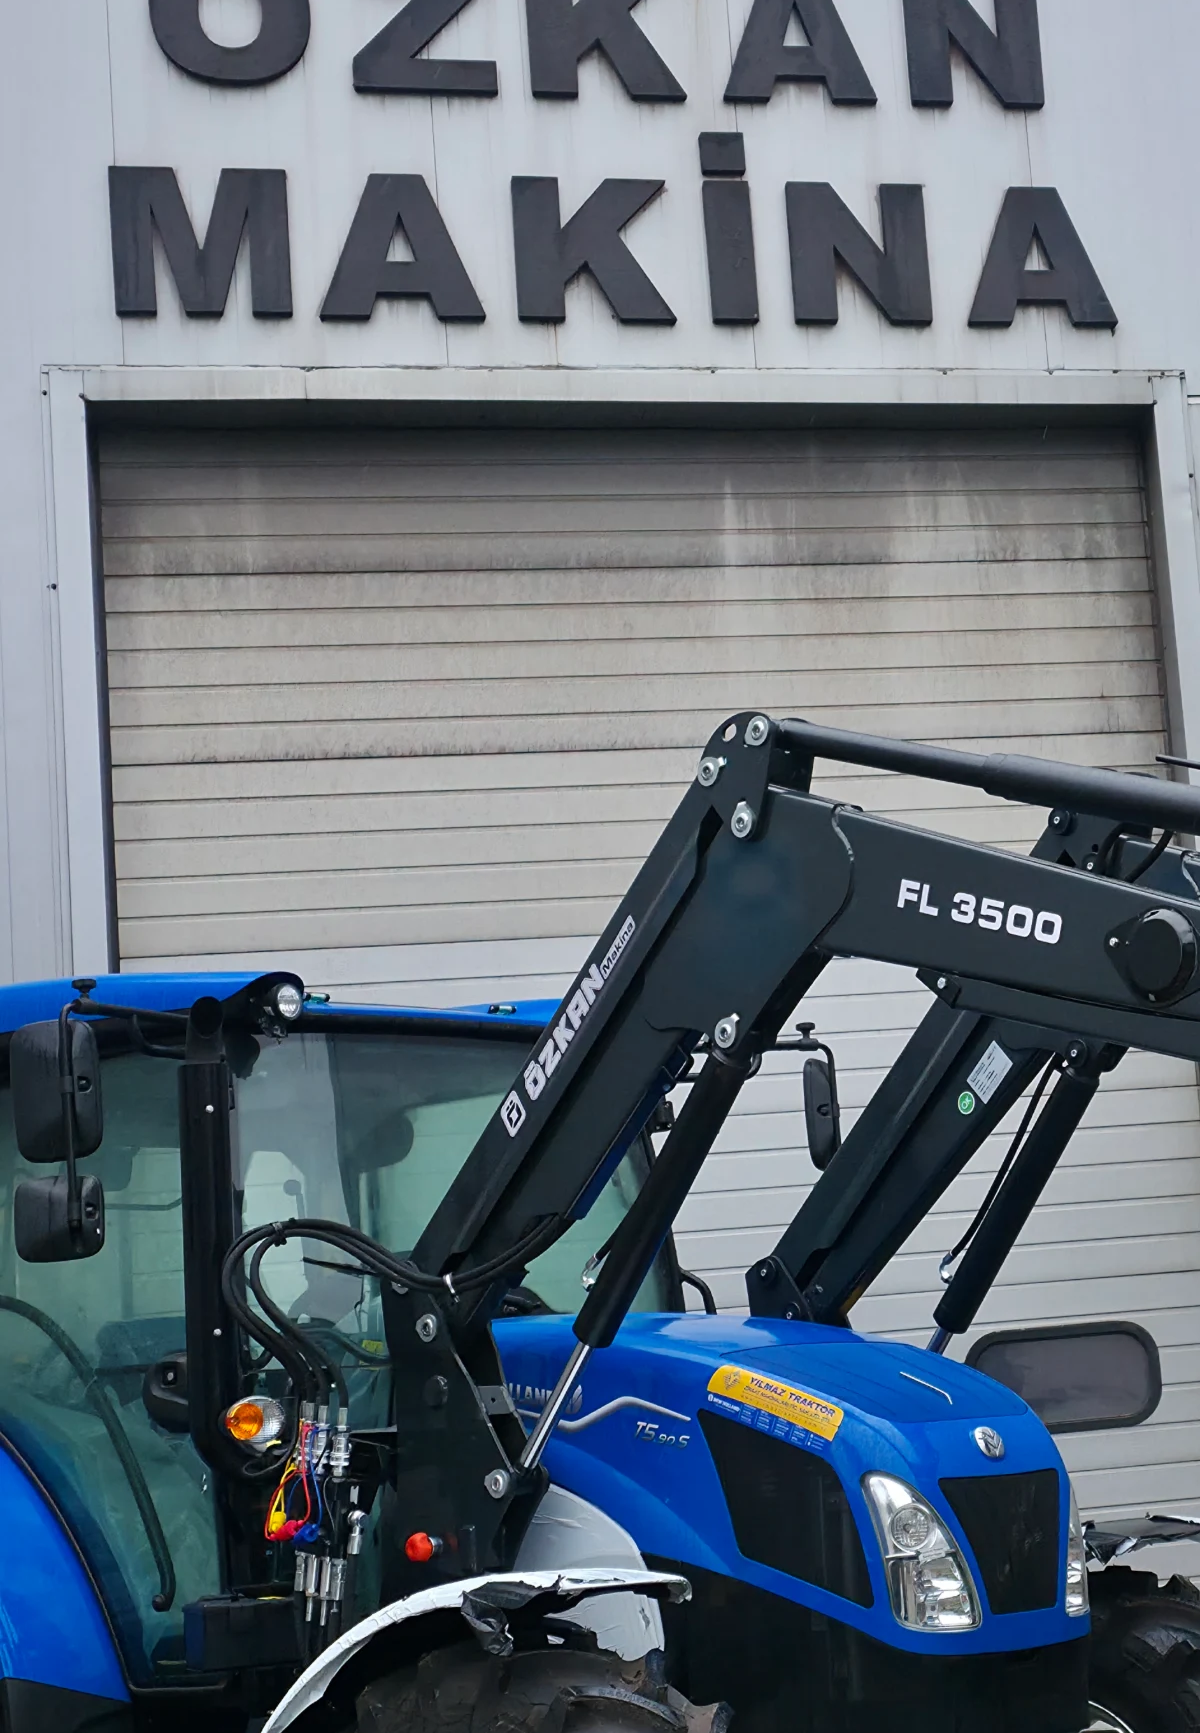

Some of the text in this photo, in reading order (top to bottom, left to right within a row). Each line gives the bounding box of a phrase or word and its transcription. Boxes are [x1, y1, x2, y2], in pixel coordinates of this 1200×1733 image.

[108, 132, 1119, 331] MAKİNA
[896, 878, 1063, 945] FL 3500
[523, 963, 605, 1101] ÖZKAN
